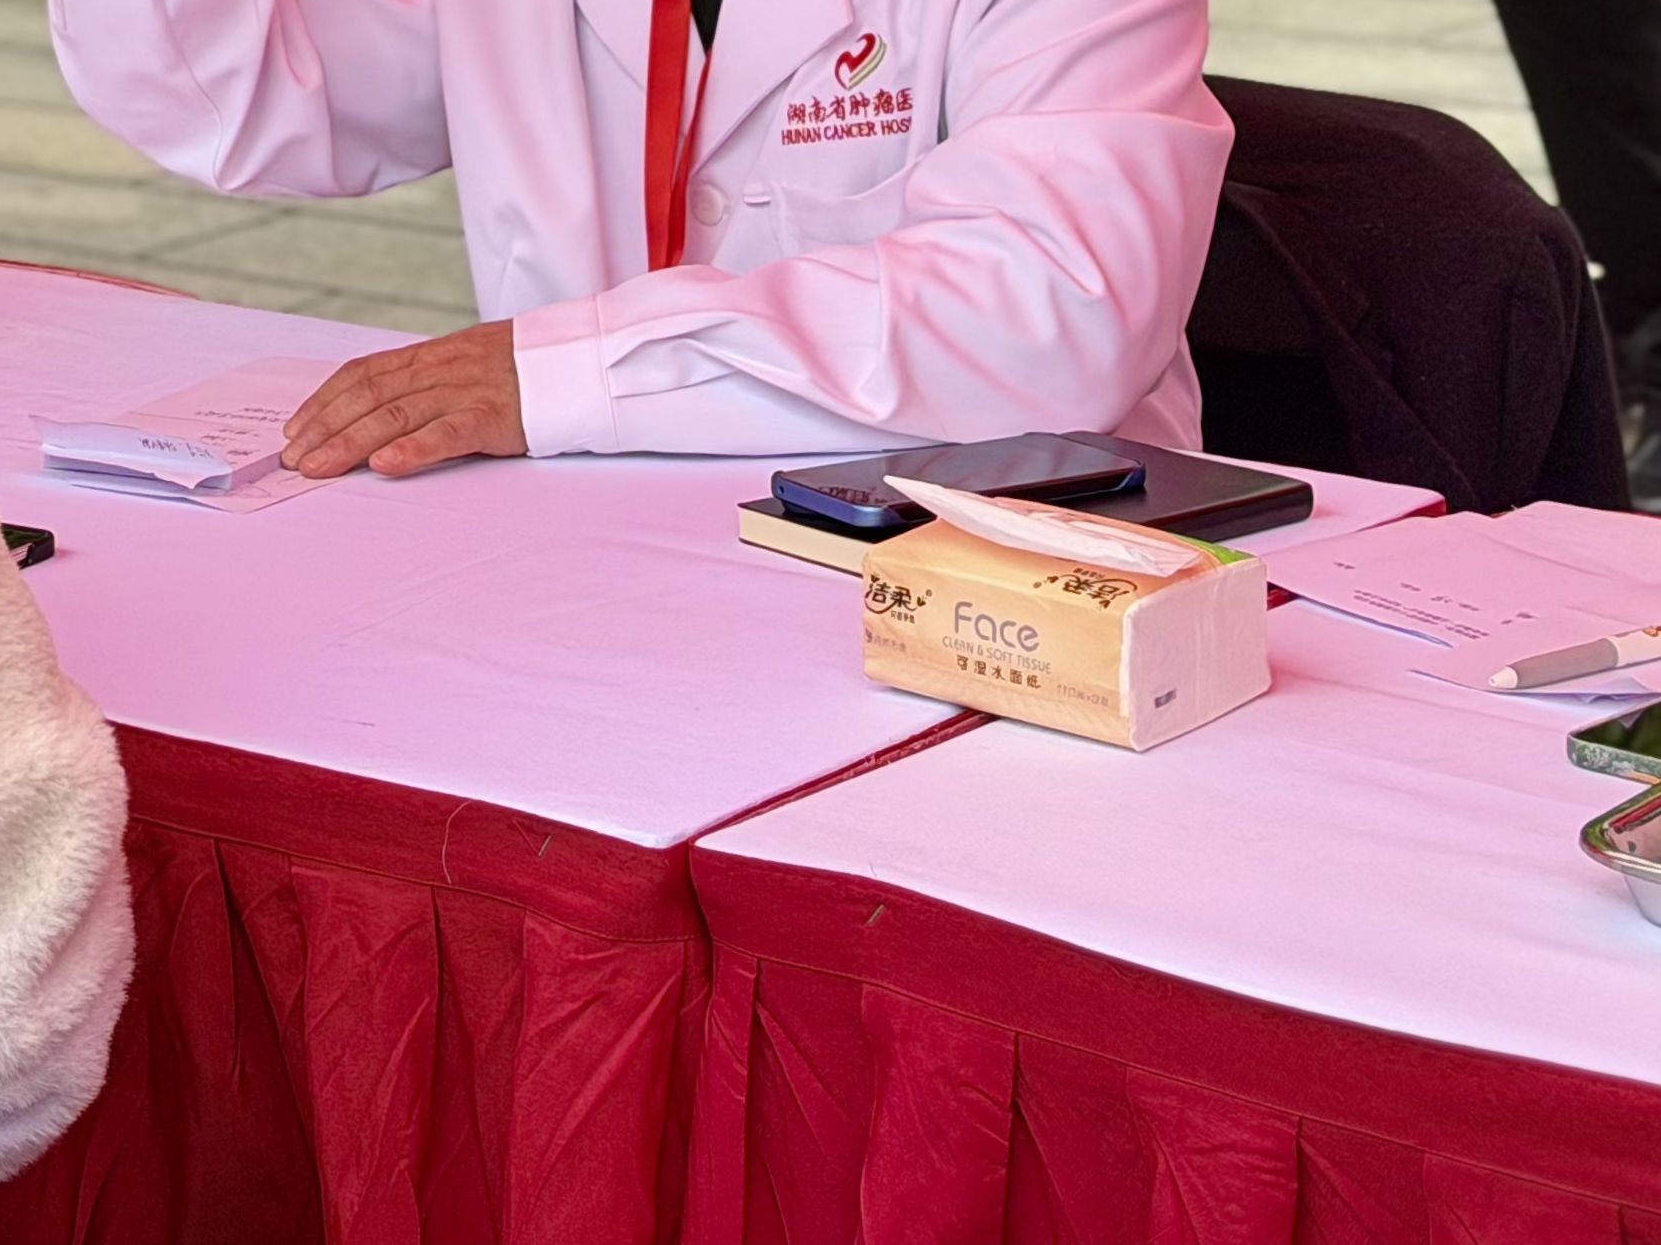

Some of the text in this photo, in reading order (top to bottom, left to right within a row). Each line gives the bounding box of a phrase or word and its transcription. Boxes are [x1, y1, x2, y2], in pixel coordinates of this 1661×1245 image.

[781, 116, 912, 145] HUNAN CANCER HOS
[954, 601, 1041, 652] Face
[956, 654, 1042, 689] 可湿水面纸
[986, 647, 1014, 664] SOFT
[1016, 654, 1052, 675] TISSUE
